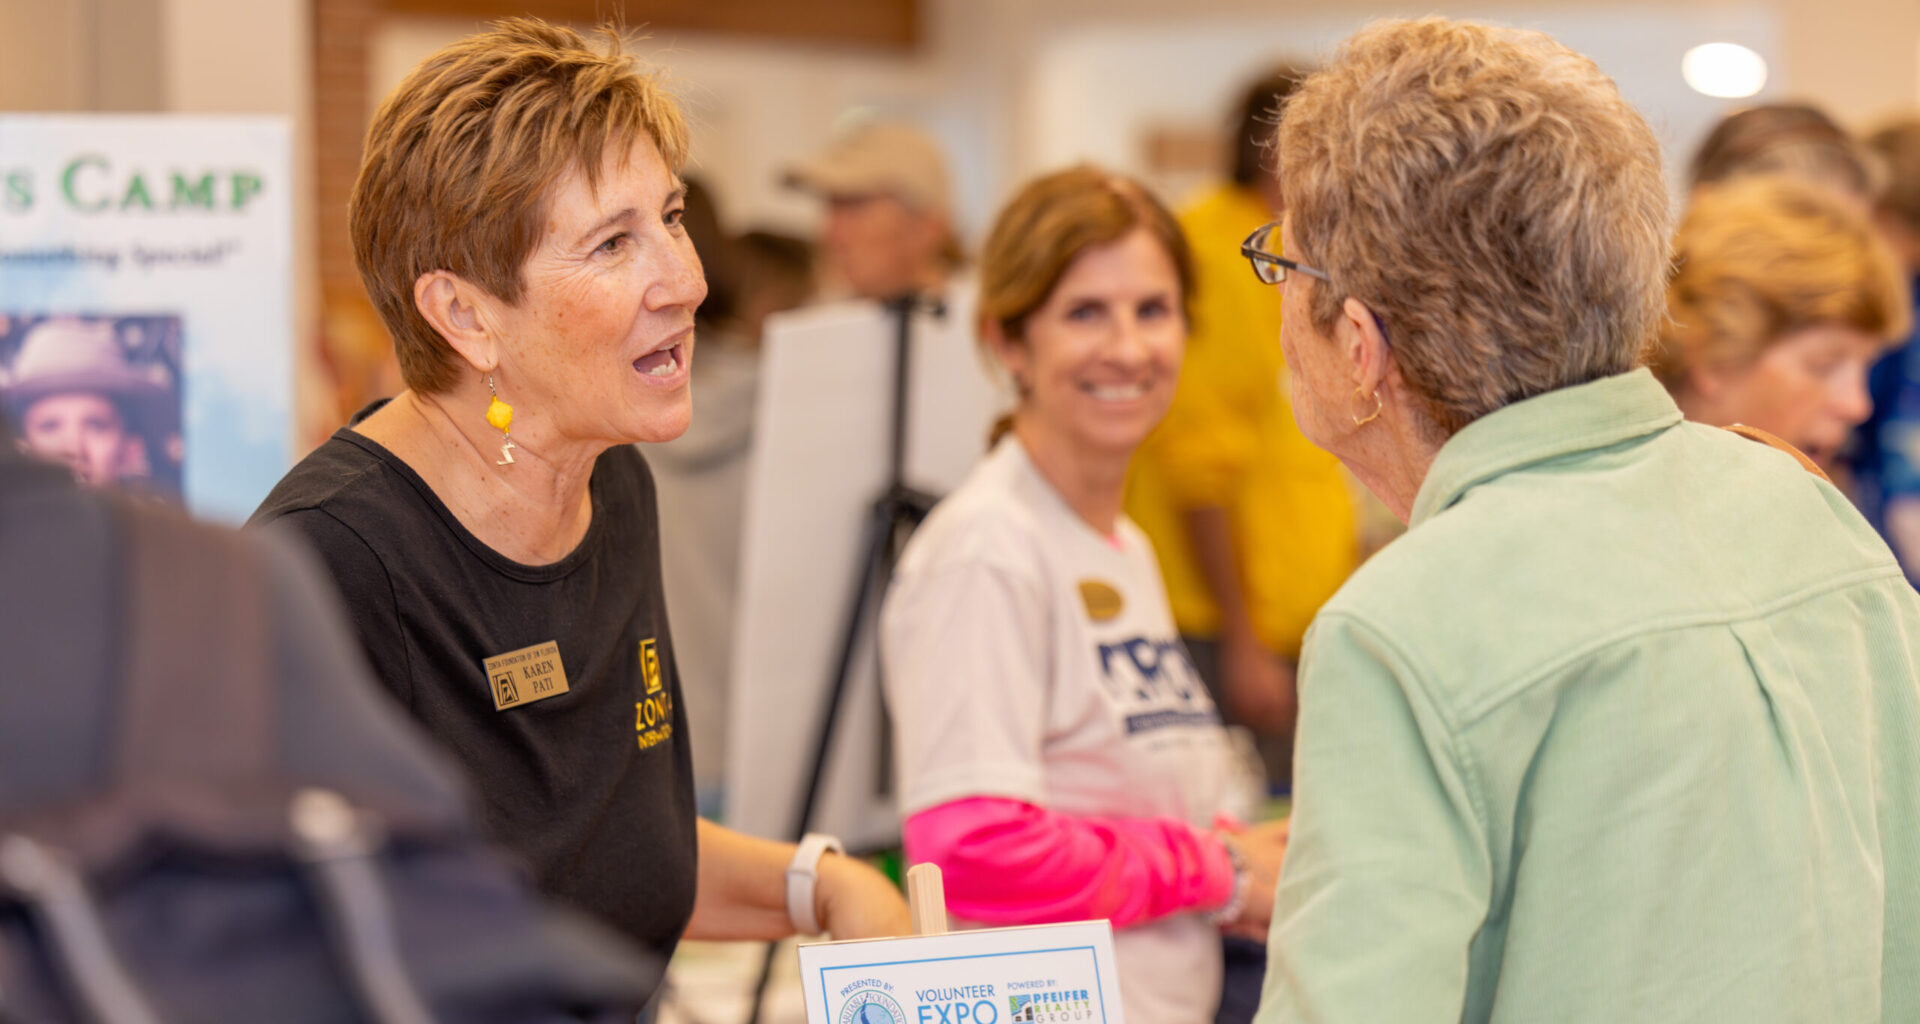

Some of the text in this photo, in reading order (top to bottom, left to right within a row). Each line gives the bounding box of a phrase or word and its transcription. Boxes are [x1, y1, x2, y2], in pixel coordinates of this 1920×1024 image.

[60, 153, 264, 212] CAMP
[523, 659, 555, 680] KAREN
[533, 677, 554, 694] PATI
[840, 978, 882, 998] PRESENTED
[915, 984, 996, 1003] VOLUNTEER
[1007, 979, 1046, 990] POWERED
[1033, 989, 1089, 1004] PFEIFER
[917, 1000, 998, 1024] EXPO
[1034, 1001, 1090, 1013] REALTY
[1036, 1009, 1092, 1024] GROUP
